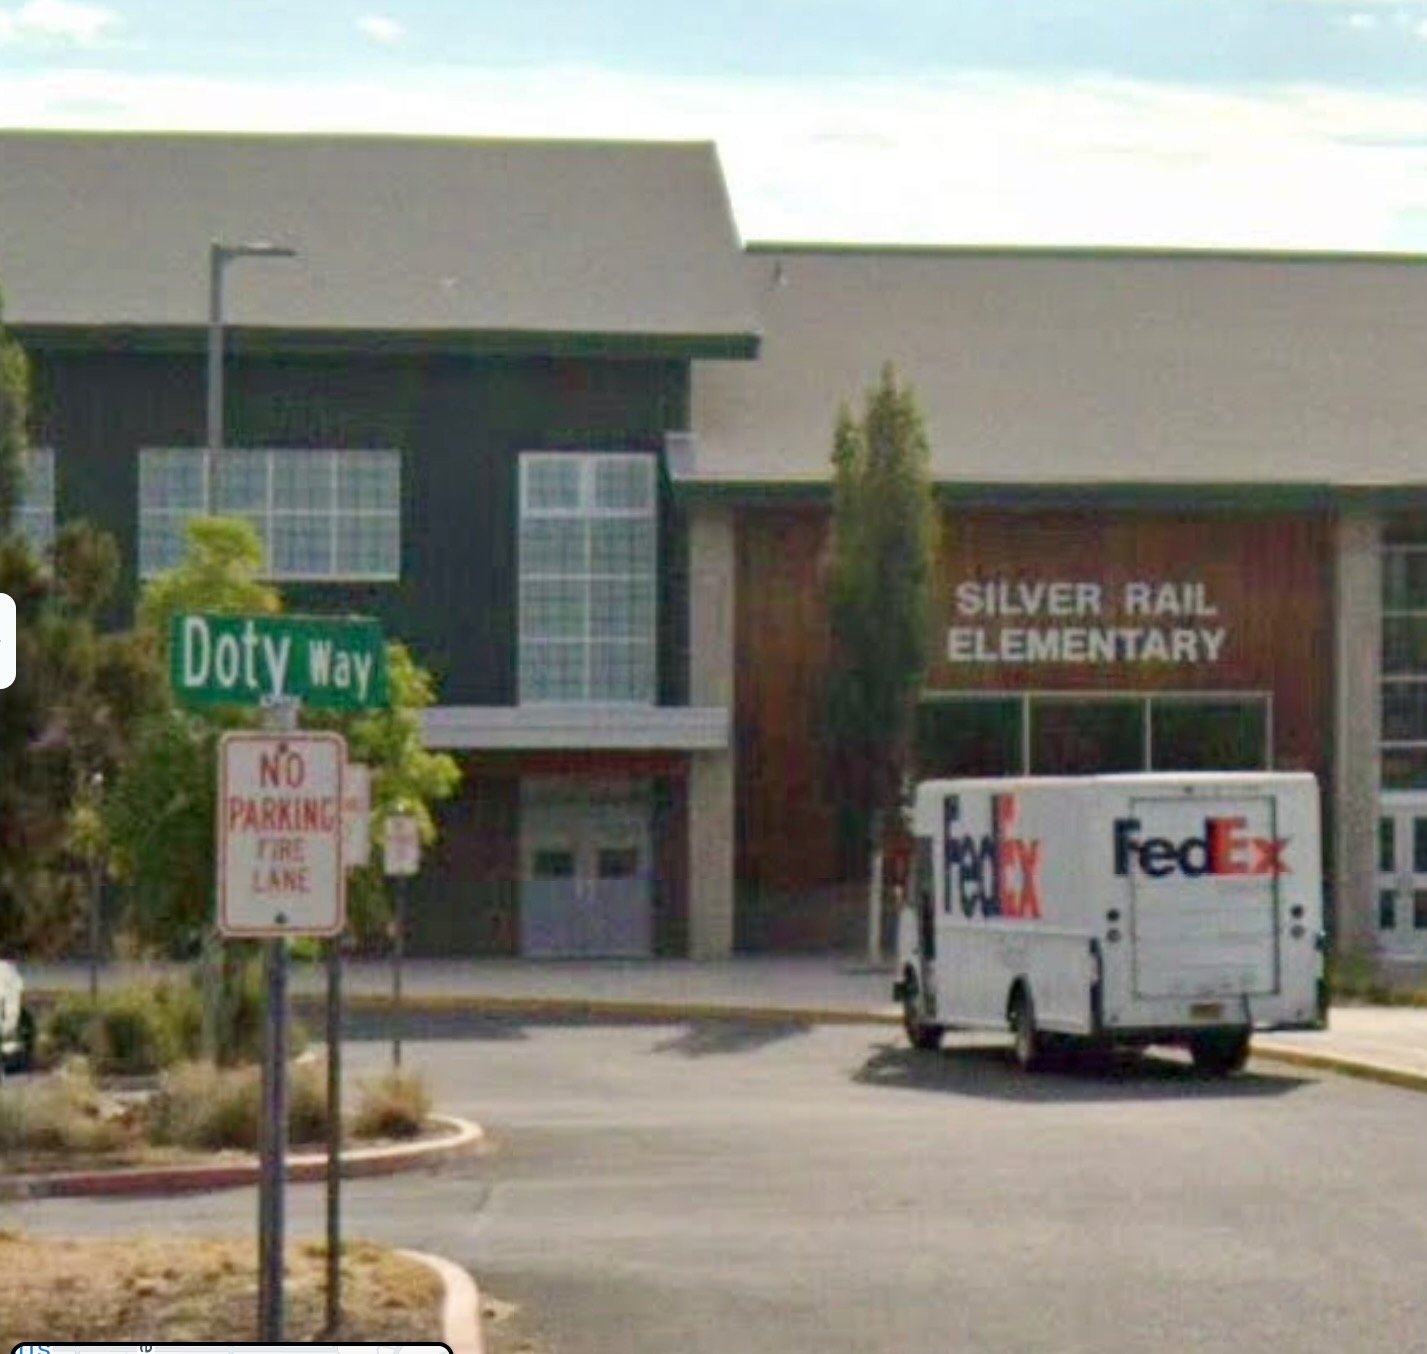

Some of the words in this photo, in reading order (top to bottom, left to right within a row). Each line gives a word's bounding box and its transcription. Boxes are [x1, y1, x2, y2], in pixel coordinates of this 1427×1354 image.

[955, 581, 1100, 616] SILVER
[1125, 581, 1217, 616] RAIL
[182, 615, 292, 697] Doty
[308, 639, 372, 700] Way
[947, 626, 1226, 663] ELEMENTARY
[259, 752, 305, 790] NO
[228, 796, 336, 833] PARKING
[257, 838, 306, 863] FIRE
[943, 794, 1042, 919] FedEx
[1113, 816, 1294, 878] FedEx
[252, 866, 311, 894] LANE
